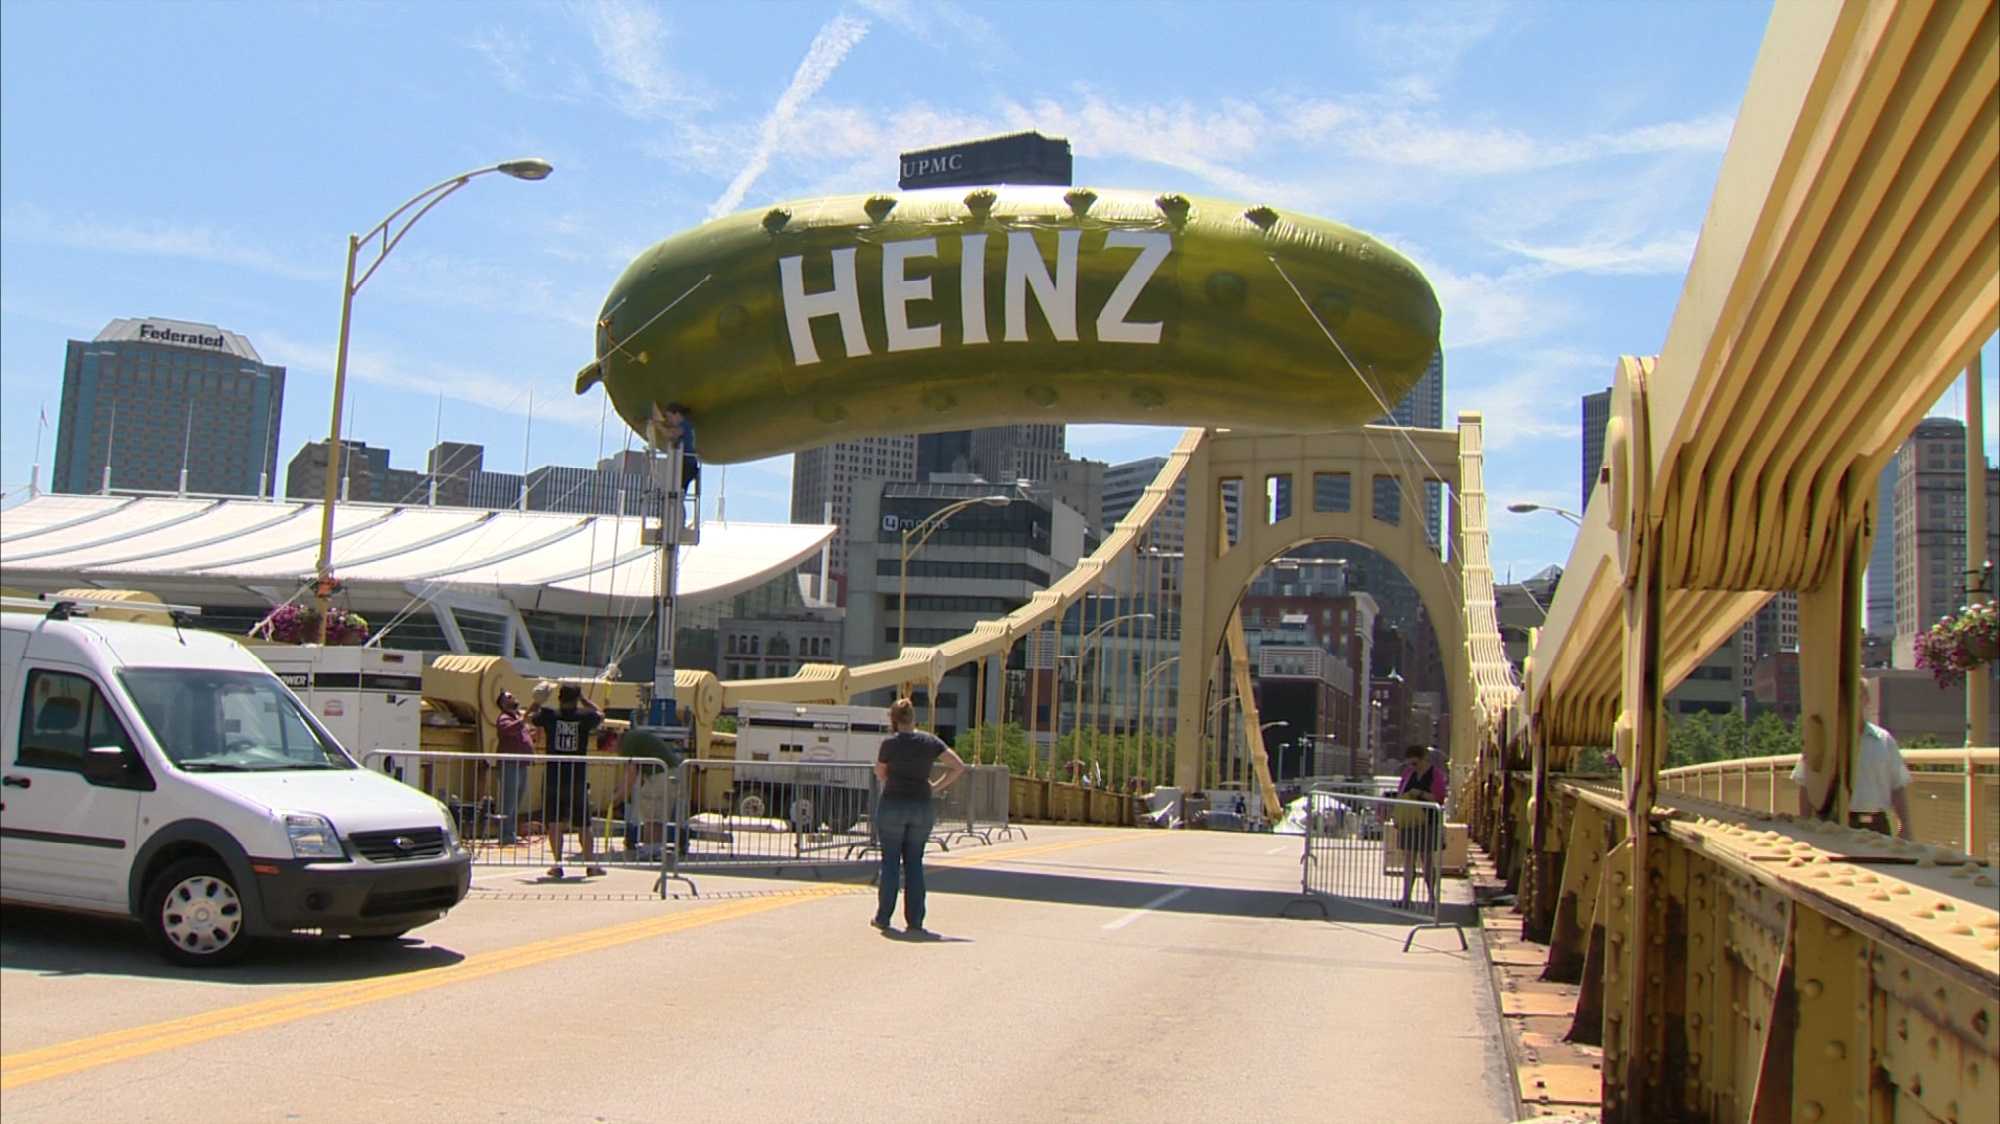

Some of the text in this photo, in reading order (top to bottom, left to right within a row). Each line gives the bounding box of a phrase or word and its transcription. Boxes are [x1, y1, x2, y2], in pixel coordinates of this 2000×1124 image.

[902, 154, 963, 178] UPMC
[779, 229, 1172, 366] HEINZ
[141, 324, 224, 348] Federated
